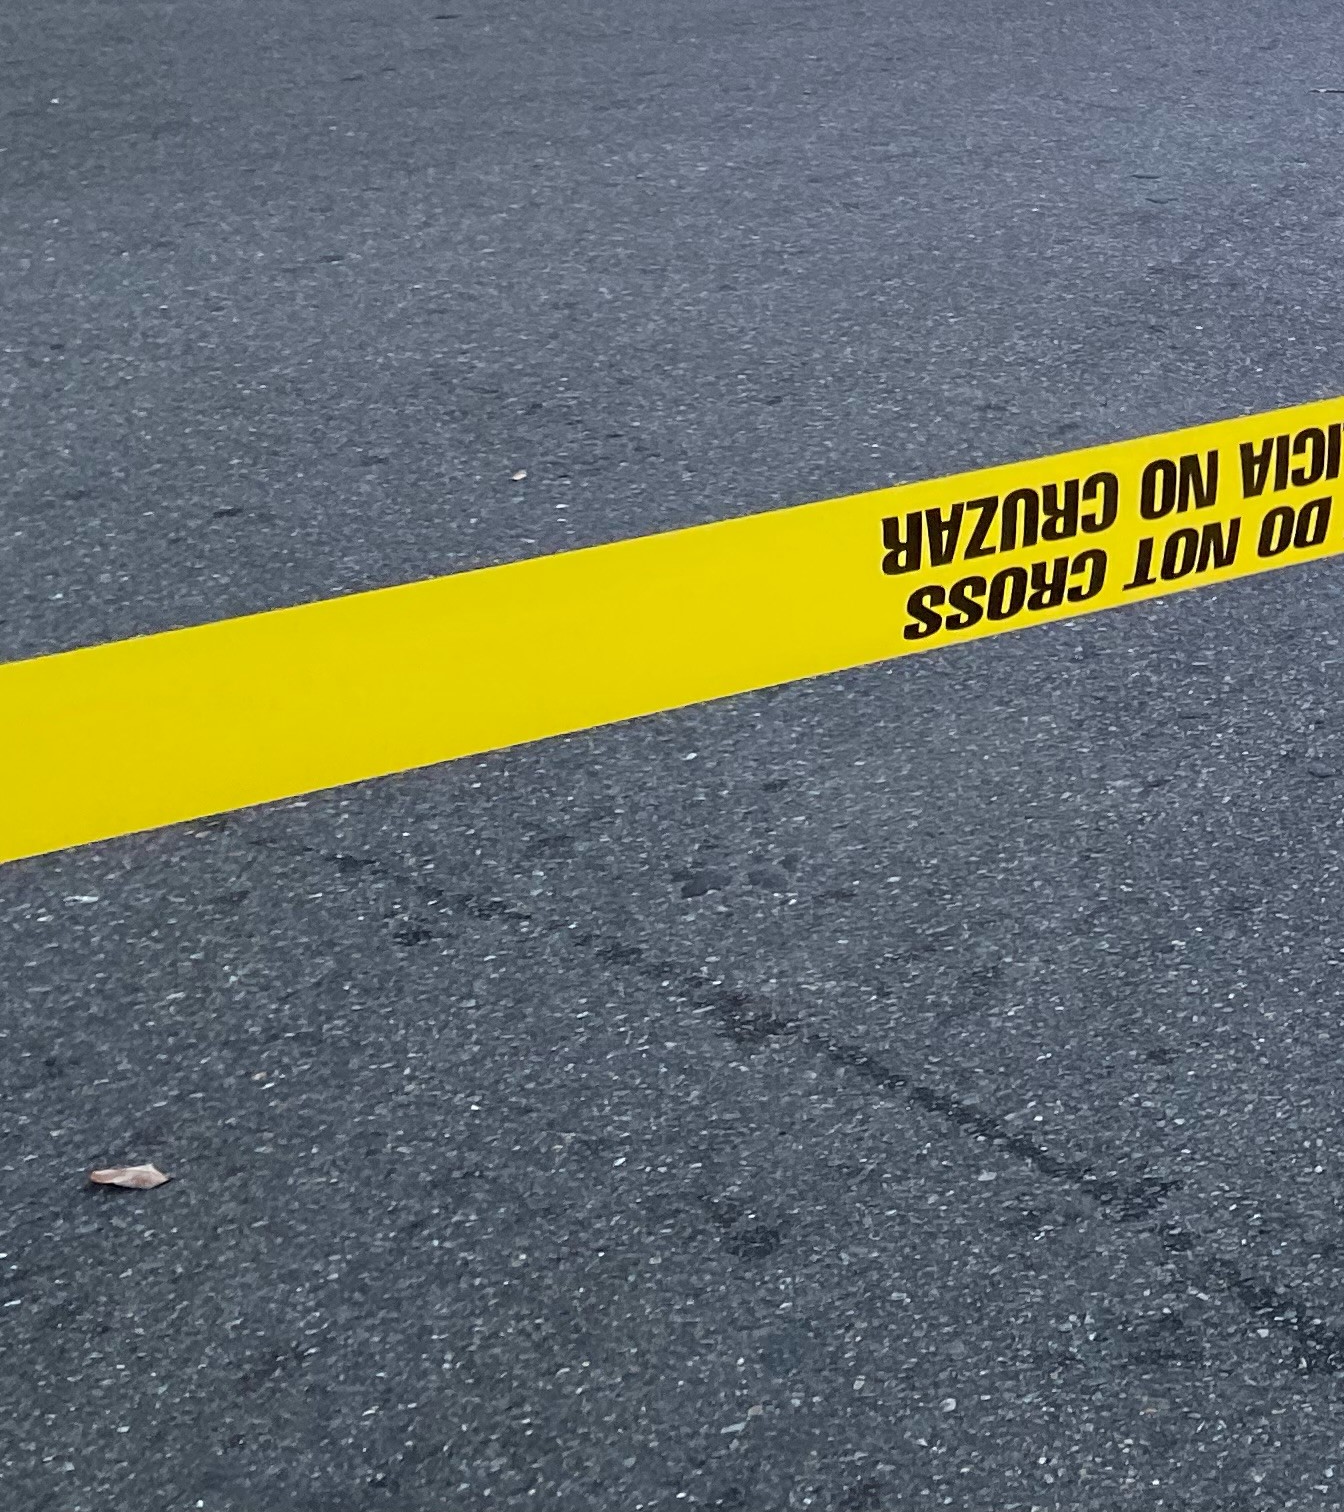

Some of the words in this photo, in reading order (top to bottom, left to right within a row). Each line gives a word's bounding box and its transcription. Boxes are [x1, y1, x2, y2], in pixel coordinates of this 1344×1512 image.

[1140, 449, 1219, 520] NO
[881, 471, 1119, 576] CRUZAR
[1122, 516, 1241, 591] NOT
[1258, 495, 1333, 558] DO
[903, 548, 1108, 641] CROSS
